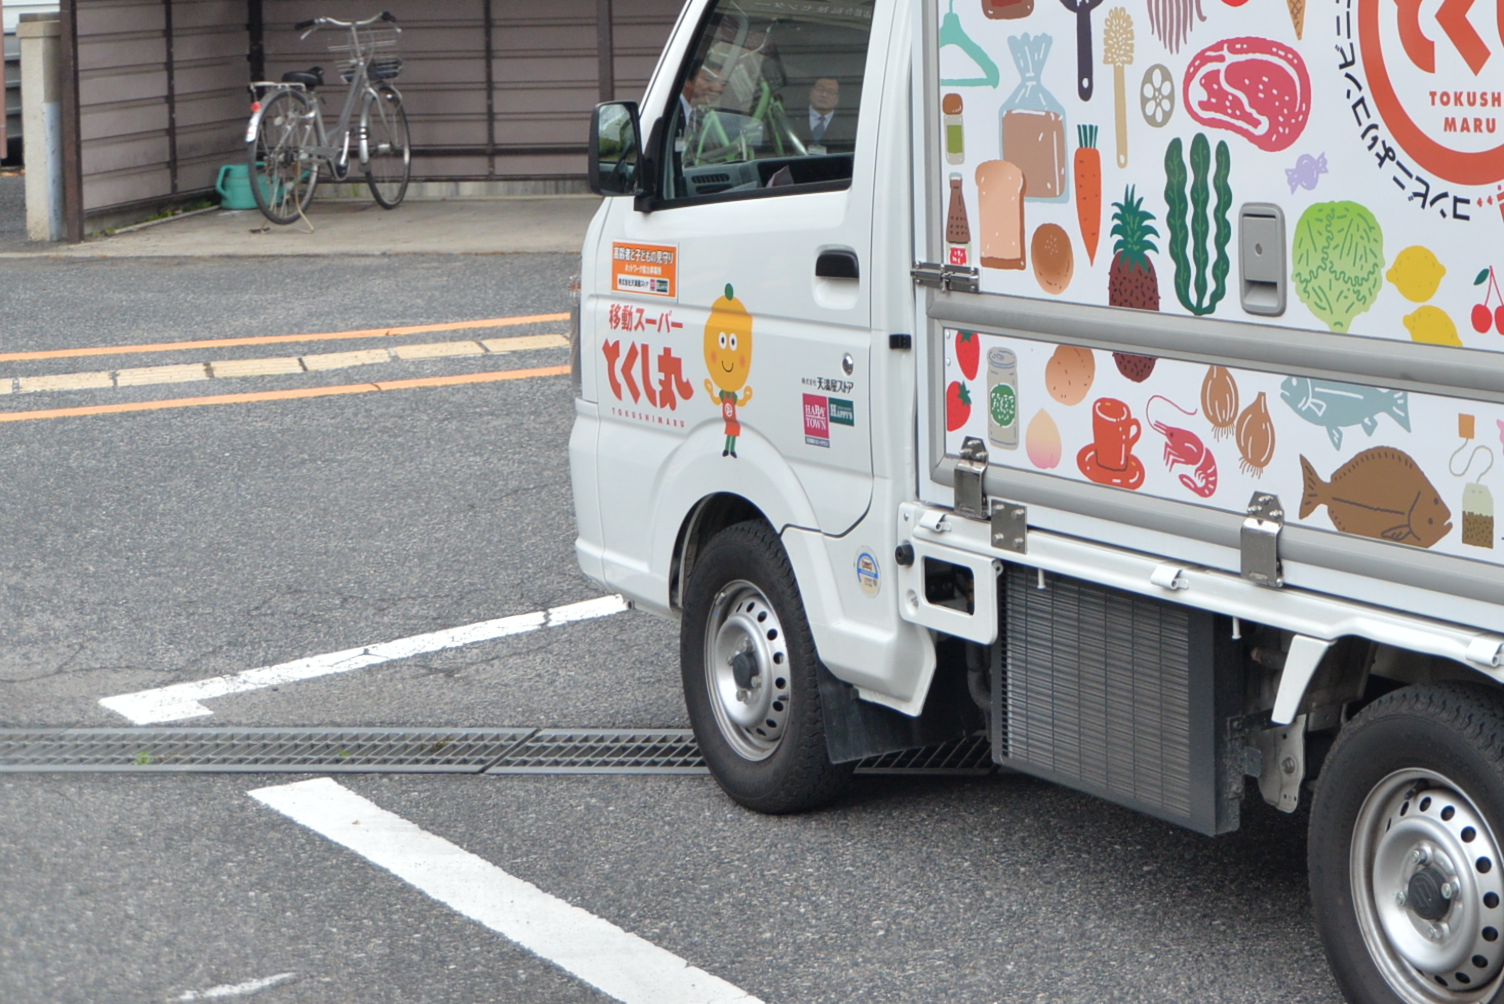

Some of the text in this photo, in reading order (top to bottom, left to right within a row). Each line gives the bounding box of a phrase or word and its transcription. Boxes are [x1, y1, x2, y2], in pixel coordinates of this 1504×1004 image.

[1443, 117, 1497, 134] MARU
[609, 303, 683, 334] 移動スーパー
[602, 338, 694, 411] とくし丸
[612, 407, 684, 428] TOKUSHIMARU
[806, 417, 827, 430] TOWN
